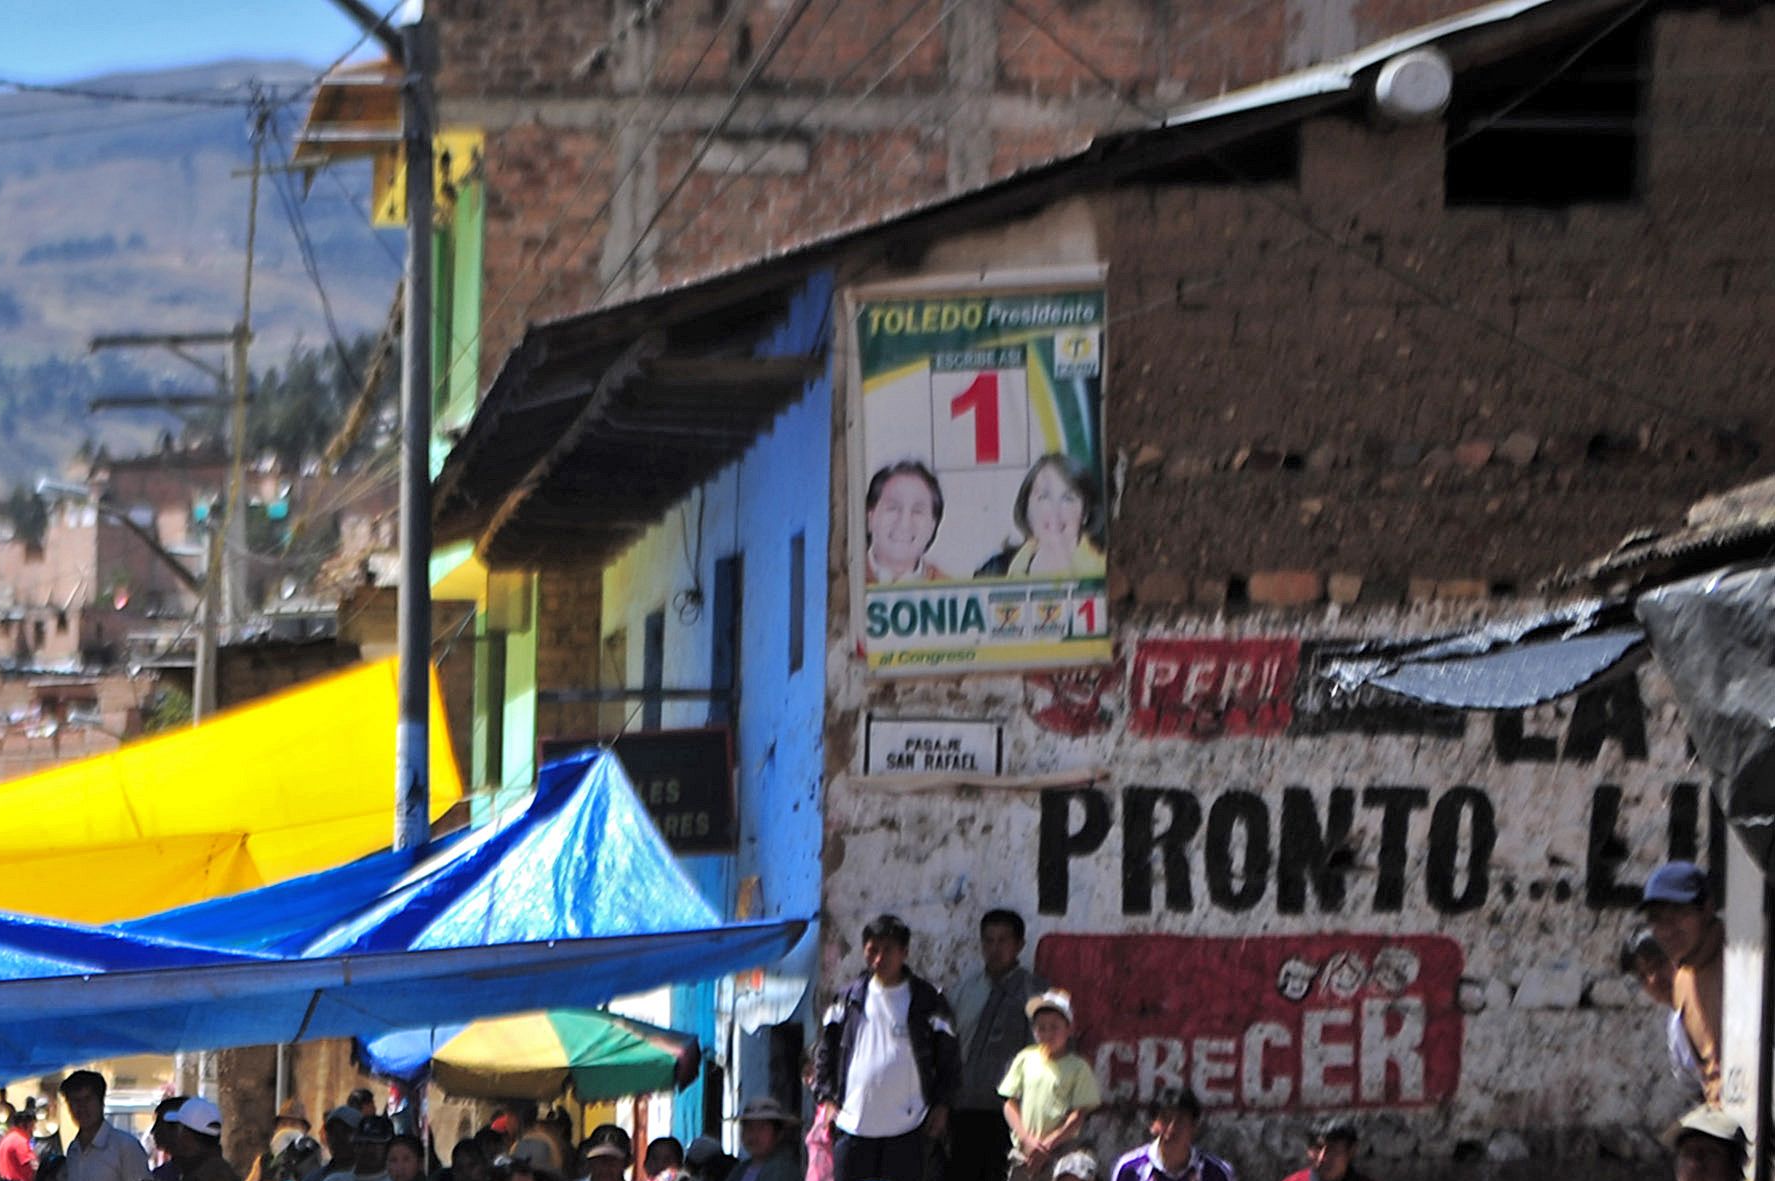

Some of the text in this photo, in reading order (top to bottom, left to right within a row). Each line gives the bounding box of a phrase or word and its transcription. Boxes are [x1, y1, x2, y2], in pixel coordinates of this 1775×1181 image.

[869, 303, 1096, 336] TOLEDO Presidente
[950, 371, 1001, 465] 1
[866, 596, 987, 638] SONIA
[1077, 597, 1097, 634] 1
[898, 650, 977, 666] Congreso
[886, 752, 979, 771] SAN RAFAEL
[905, 737, 963, 751] PASAJE
[1091, 995, 1424, 1108] CRECER
